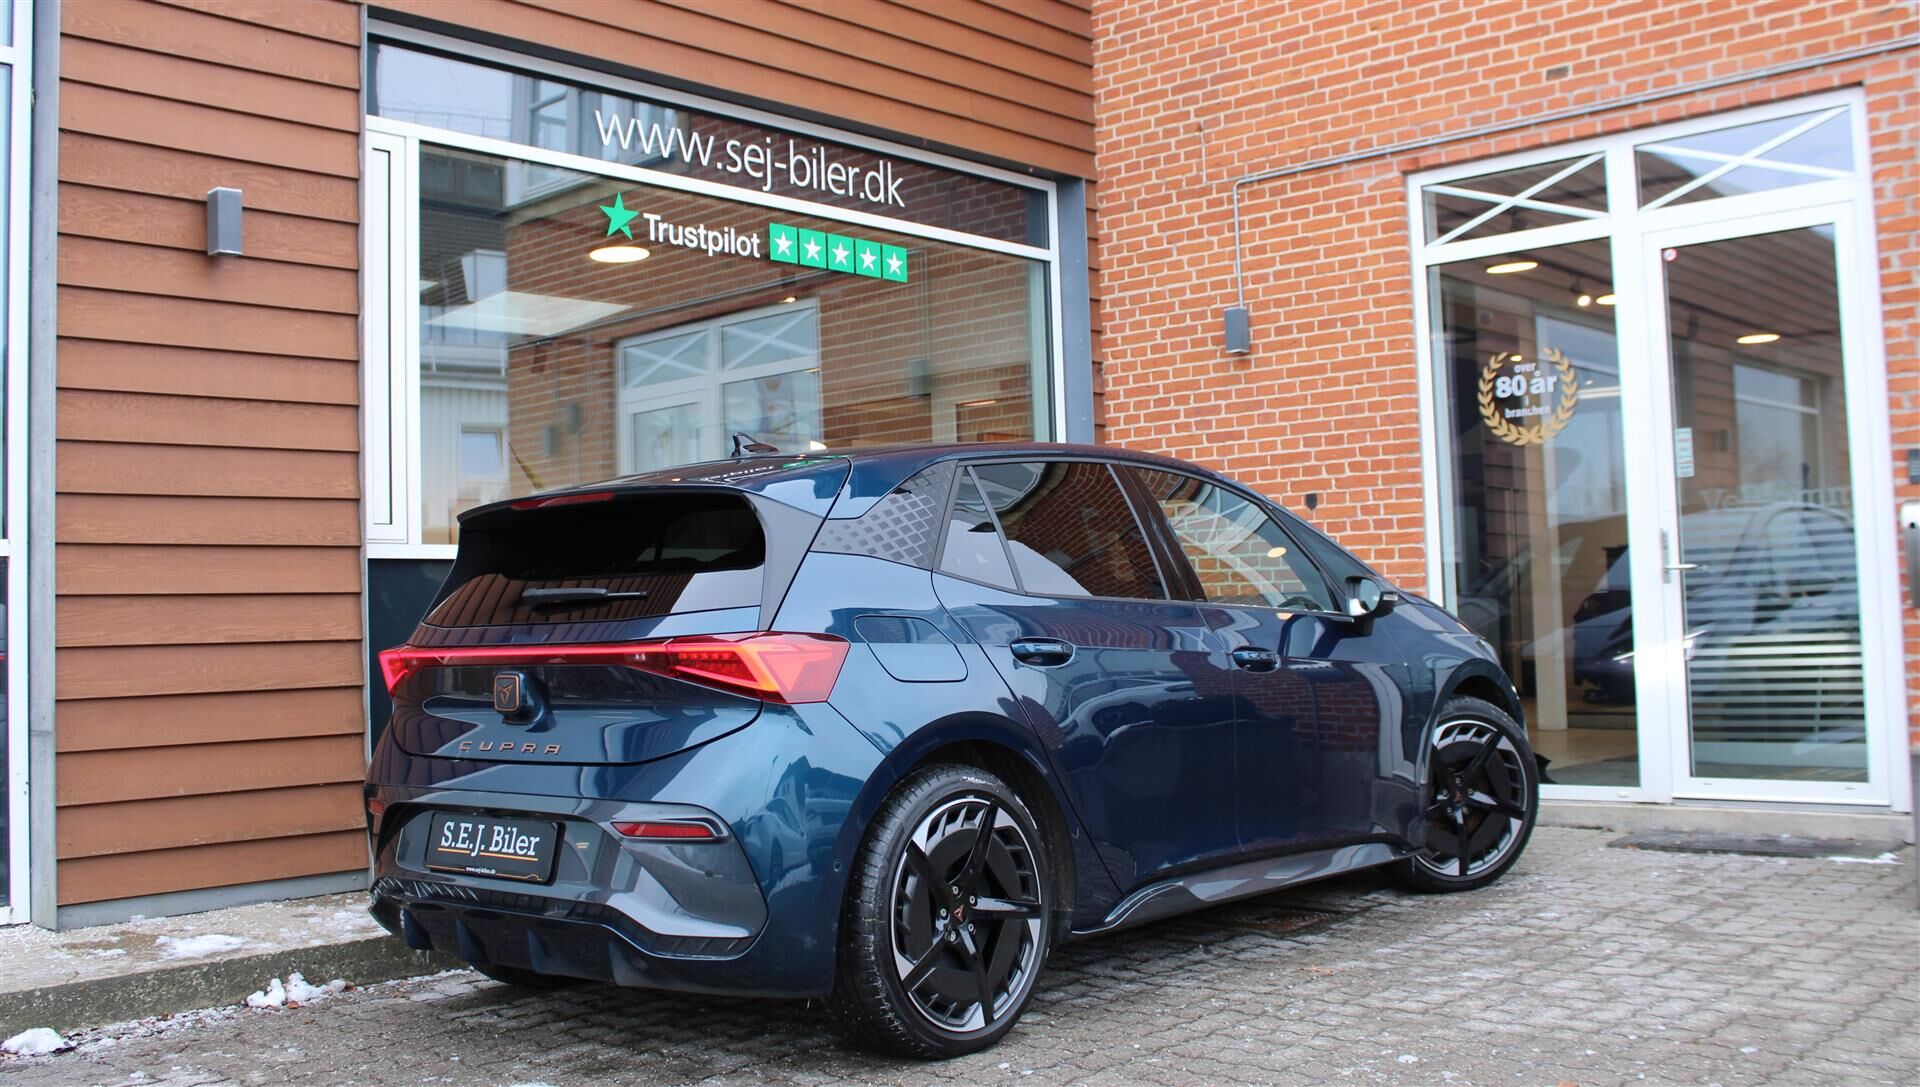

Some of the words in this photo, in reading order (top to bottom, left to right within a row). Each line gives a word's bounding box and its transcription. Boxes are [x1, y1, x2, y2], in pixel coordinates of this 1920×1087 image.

[595, 110, 905, 207] www.sej-biler.dk
[643, 212, 760, 258] Trustpilot
[1514, 362, 1536, 373] over
[1496, 375, 1527, 398] 80
[1530, 370, 1557, 394] år
[1505, 406, 1550, 418] branchen
[459, 741, 560, 754] CUPRA
[441, 821, 485, 857] S.E.J.
[489, 826, 540, 855] Biler
